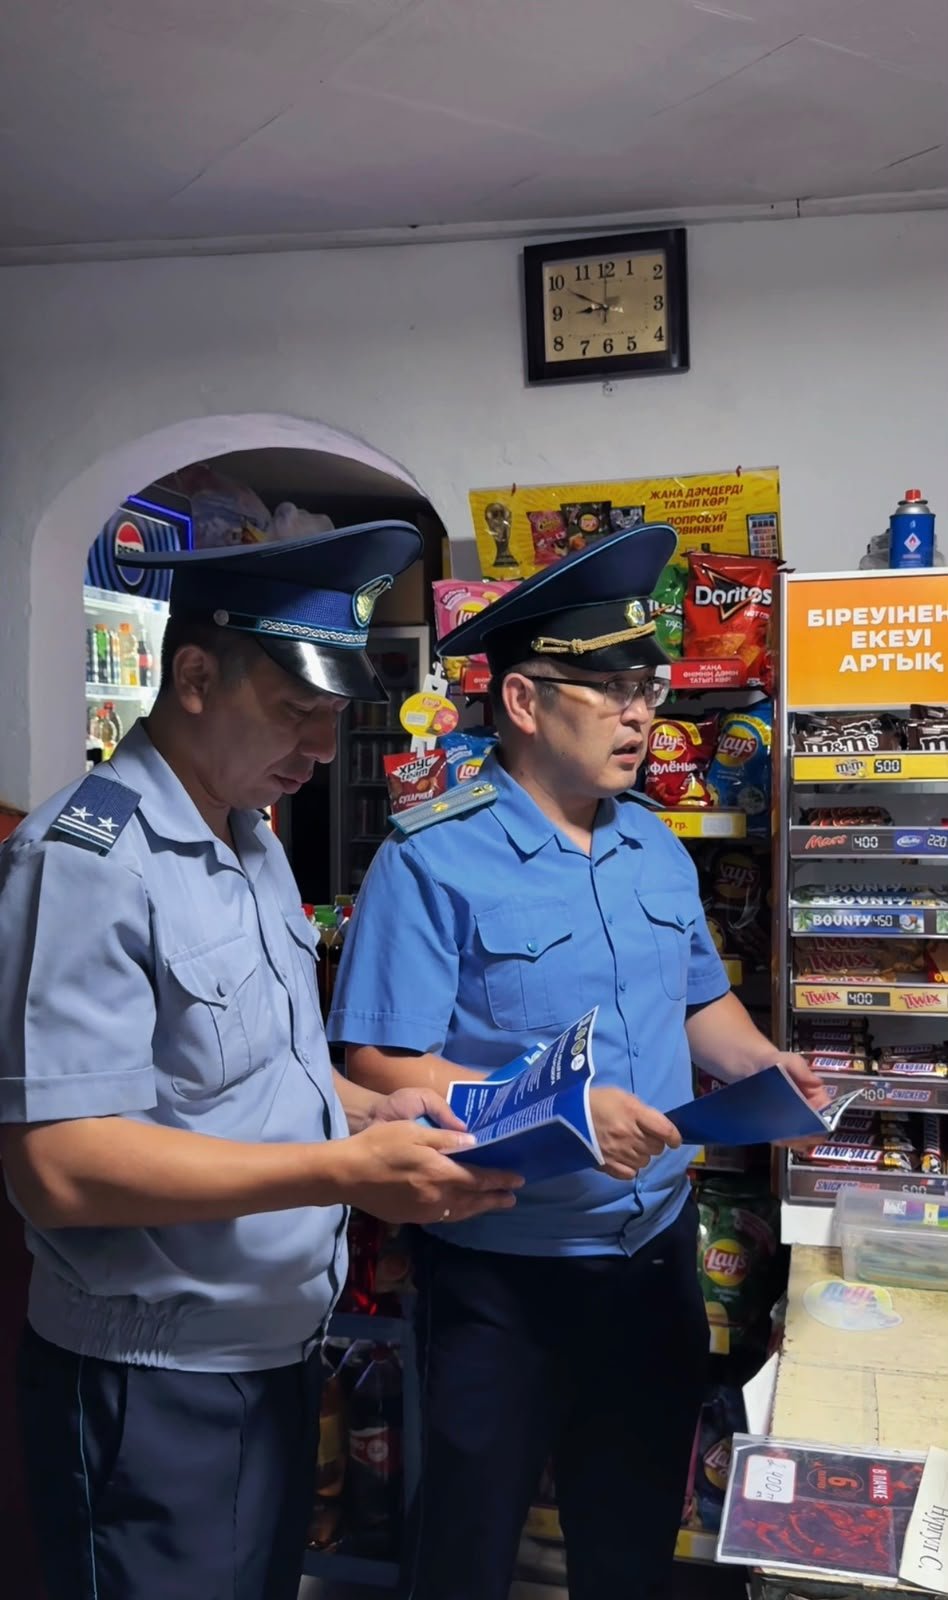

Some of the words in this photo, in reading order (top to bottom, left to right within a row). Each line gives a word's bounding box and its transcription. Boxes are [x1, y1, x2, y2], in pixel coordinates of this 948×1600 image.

[575, 265, 591, 281] 11
[597, 261, 616, 279] 12
[626, 260, 634, 276] 1
[653, 264, 663, 280] 2
[548, 275, 565, 291] 10
[653, 295, 664, 311] 3
[552, 306, 563, 321] 9
[653, 326, 664, 342] 4
[553, 336, 564, 351] 8
[580, 340, 590, 356] 7
[603, 338, 614, 354] 6
[627, 336, 637, 351] 5
[664, 499, 699, 510] ТАТЫП
[667, 511, 728, 525] ПОПРОБУЙ
[675, 524, 724, 536] ОВИНКИ!
[695, 585, 773, 606] Doritos
[807, 604, 948, 627] БІРЕУІНЕН
[851, 628, 931, 649] ЕКЕУІ
[839, 652, 944, 673] АРТЫҚ
[875, 760, 900, 772] 500
[805, 834, 848, 850] Mars
[854, 836, 879, 848] 400
[927, 833, 948, 848] 220
[812, 914, 873, 927] BOUNTY
[849, 992, 873, 1005] 400
[861, 1088, 885, 1101] 400
[891, 1090, 930, 1101] SNICKERS
[828, 1476, 858, 1489] 6
[920, 1505, 948, 1553] Нургул
